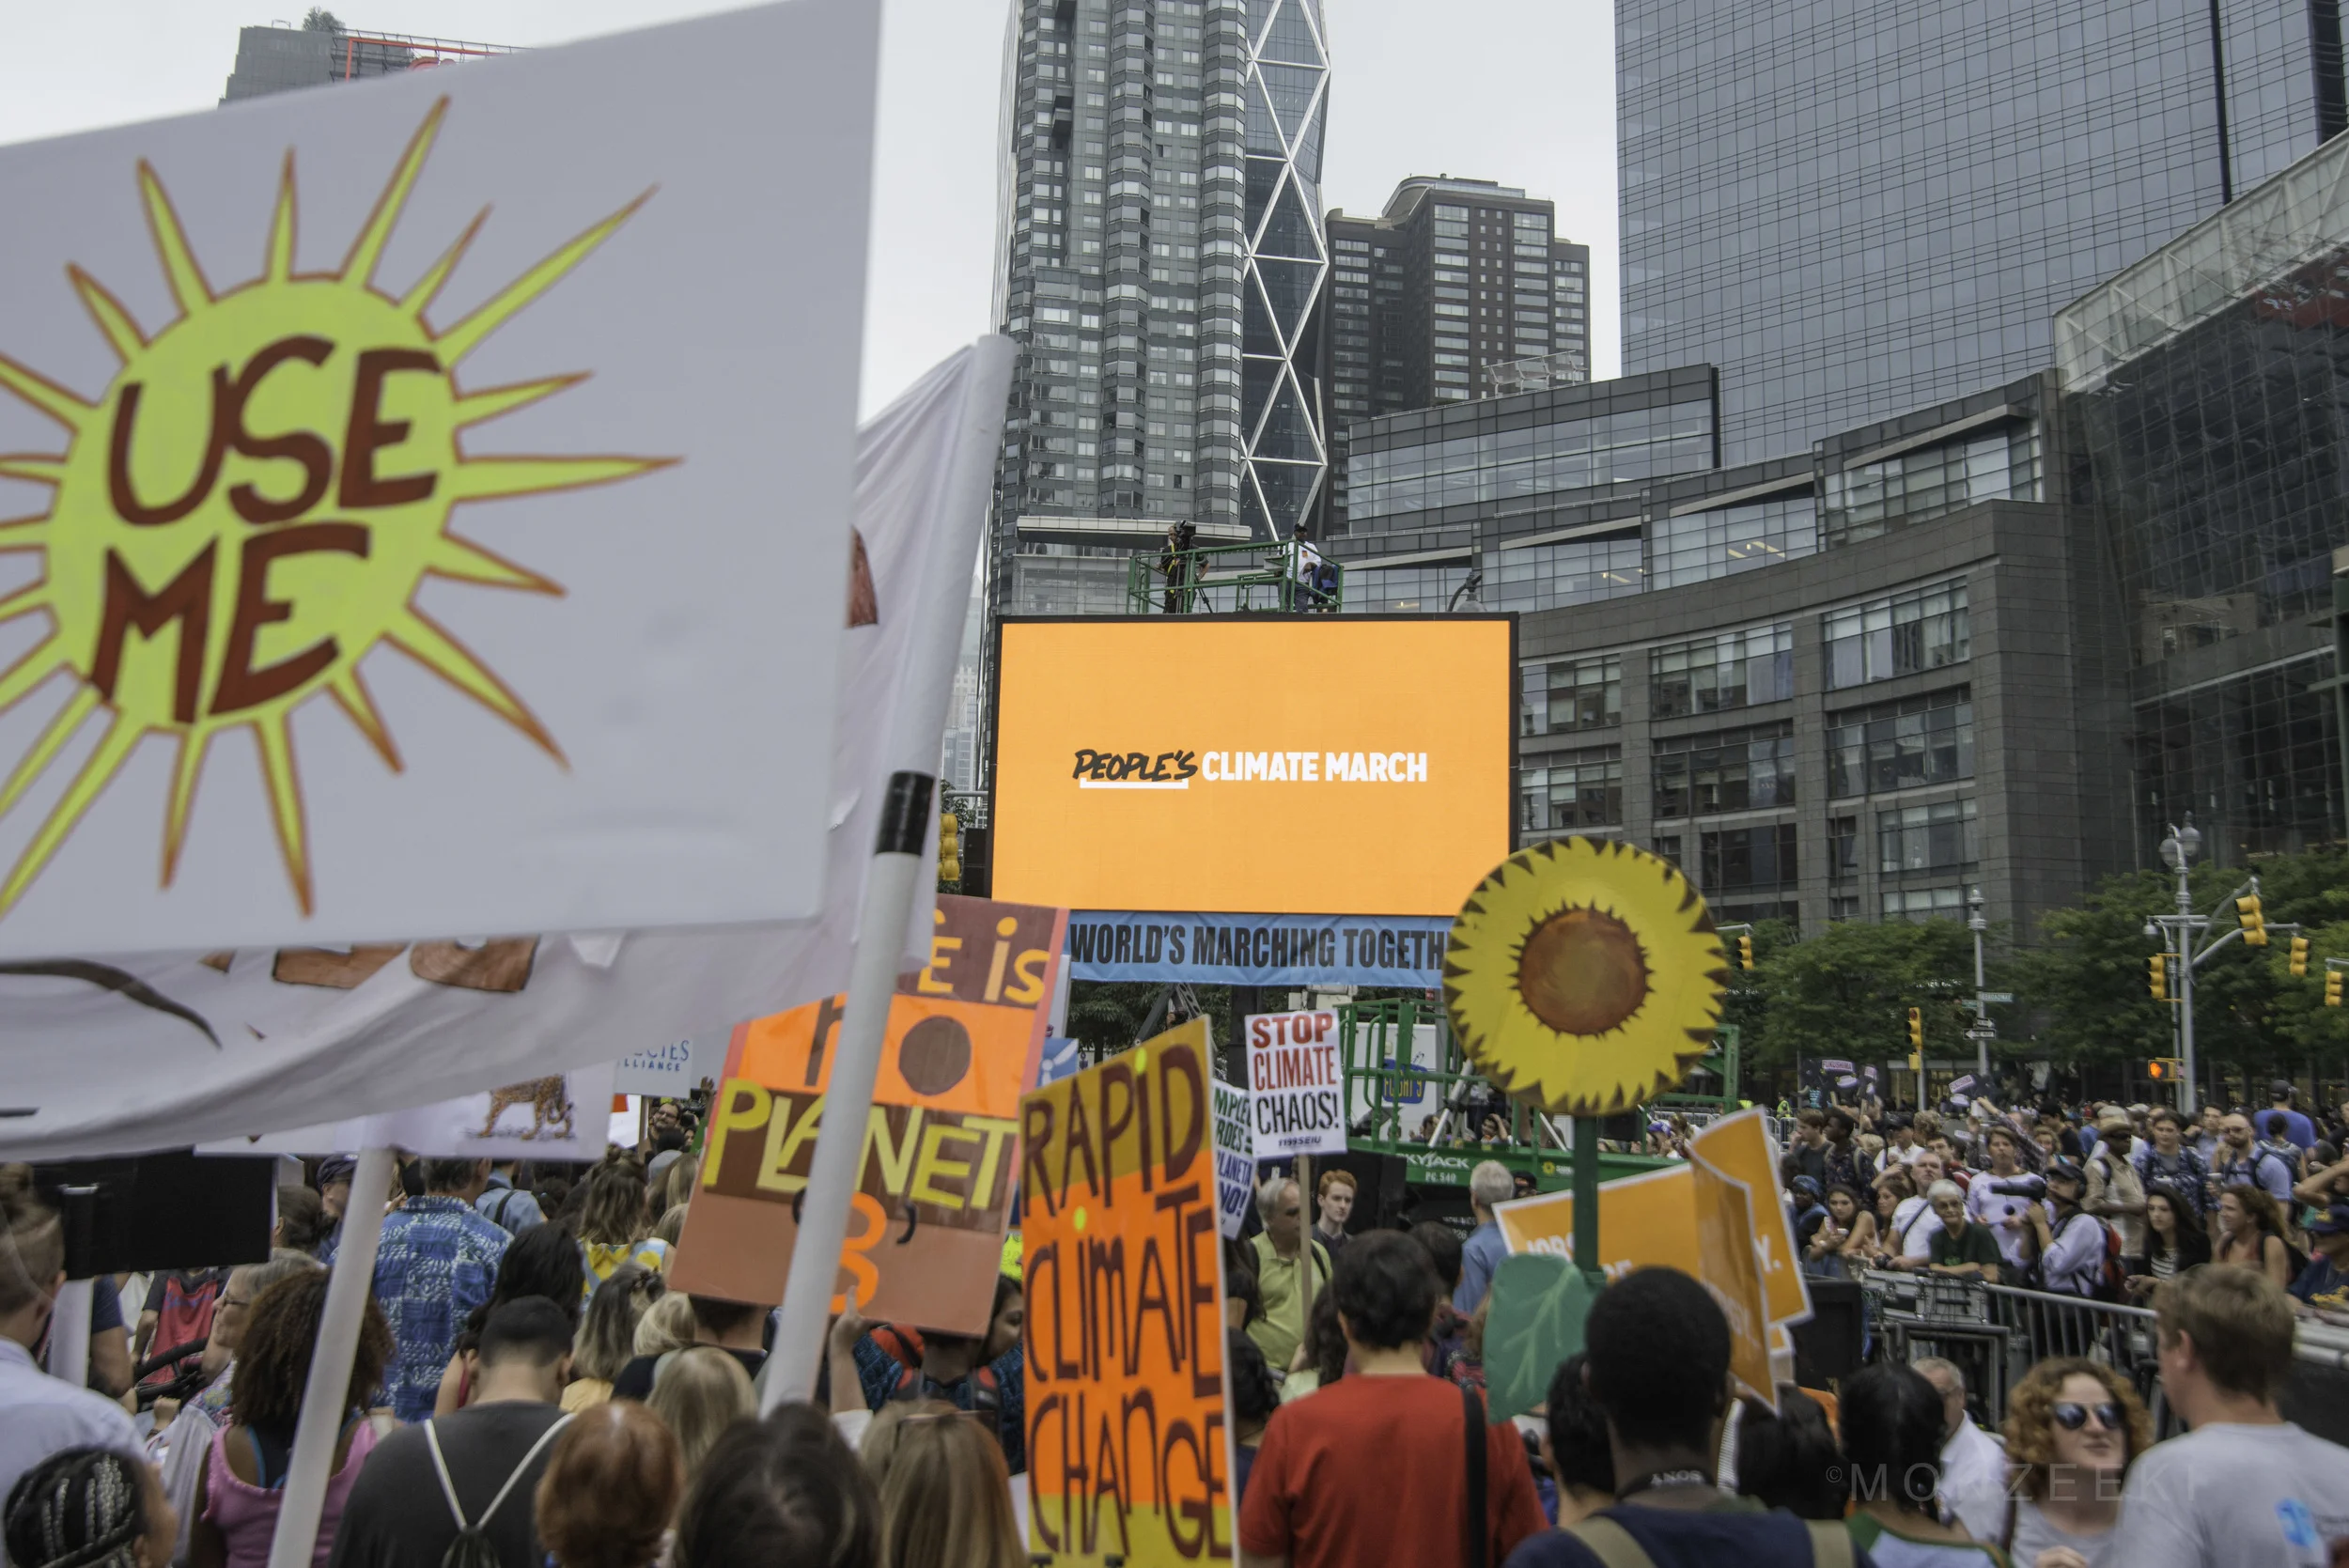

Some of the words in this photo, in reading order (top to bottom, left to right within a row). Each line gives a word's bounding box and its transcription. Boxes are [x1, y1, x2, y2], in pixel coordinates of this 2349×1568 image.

[108, 334, 444, 525] USE
[90, 521, 371, 725] ME
[1072, 749, 1198, 782] PEOPLE'S
[1202, 751, 1318, 782] CLIMATE
[1326, 752, 1427, 782] MARCH
[1070, 923, 1186, 965] WORLD'S
[1191, 925, 1335, 968] MARCHING
[1343, 928, 1449, 970] TOGETH
[1252, 1013, 1332, 1048] STOP
[1252, 1046, 1336, 1091] CLIMATE
[1216, 1117, 1243, 1153] RDES
[1256, 1091, 1339, 1135] CHAOS!
[1395, 1152, 1470, 1169] KYJACK
[1024, 1181, 1221, 1399] CLIMATE
[1030, 1387, 1233, 1560] CHANGE
